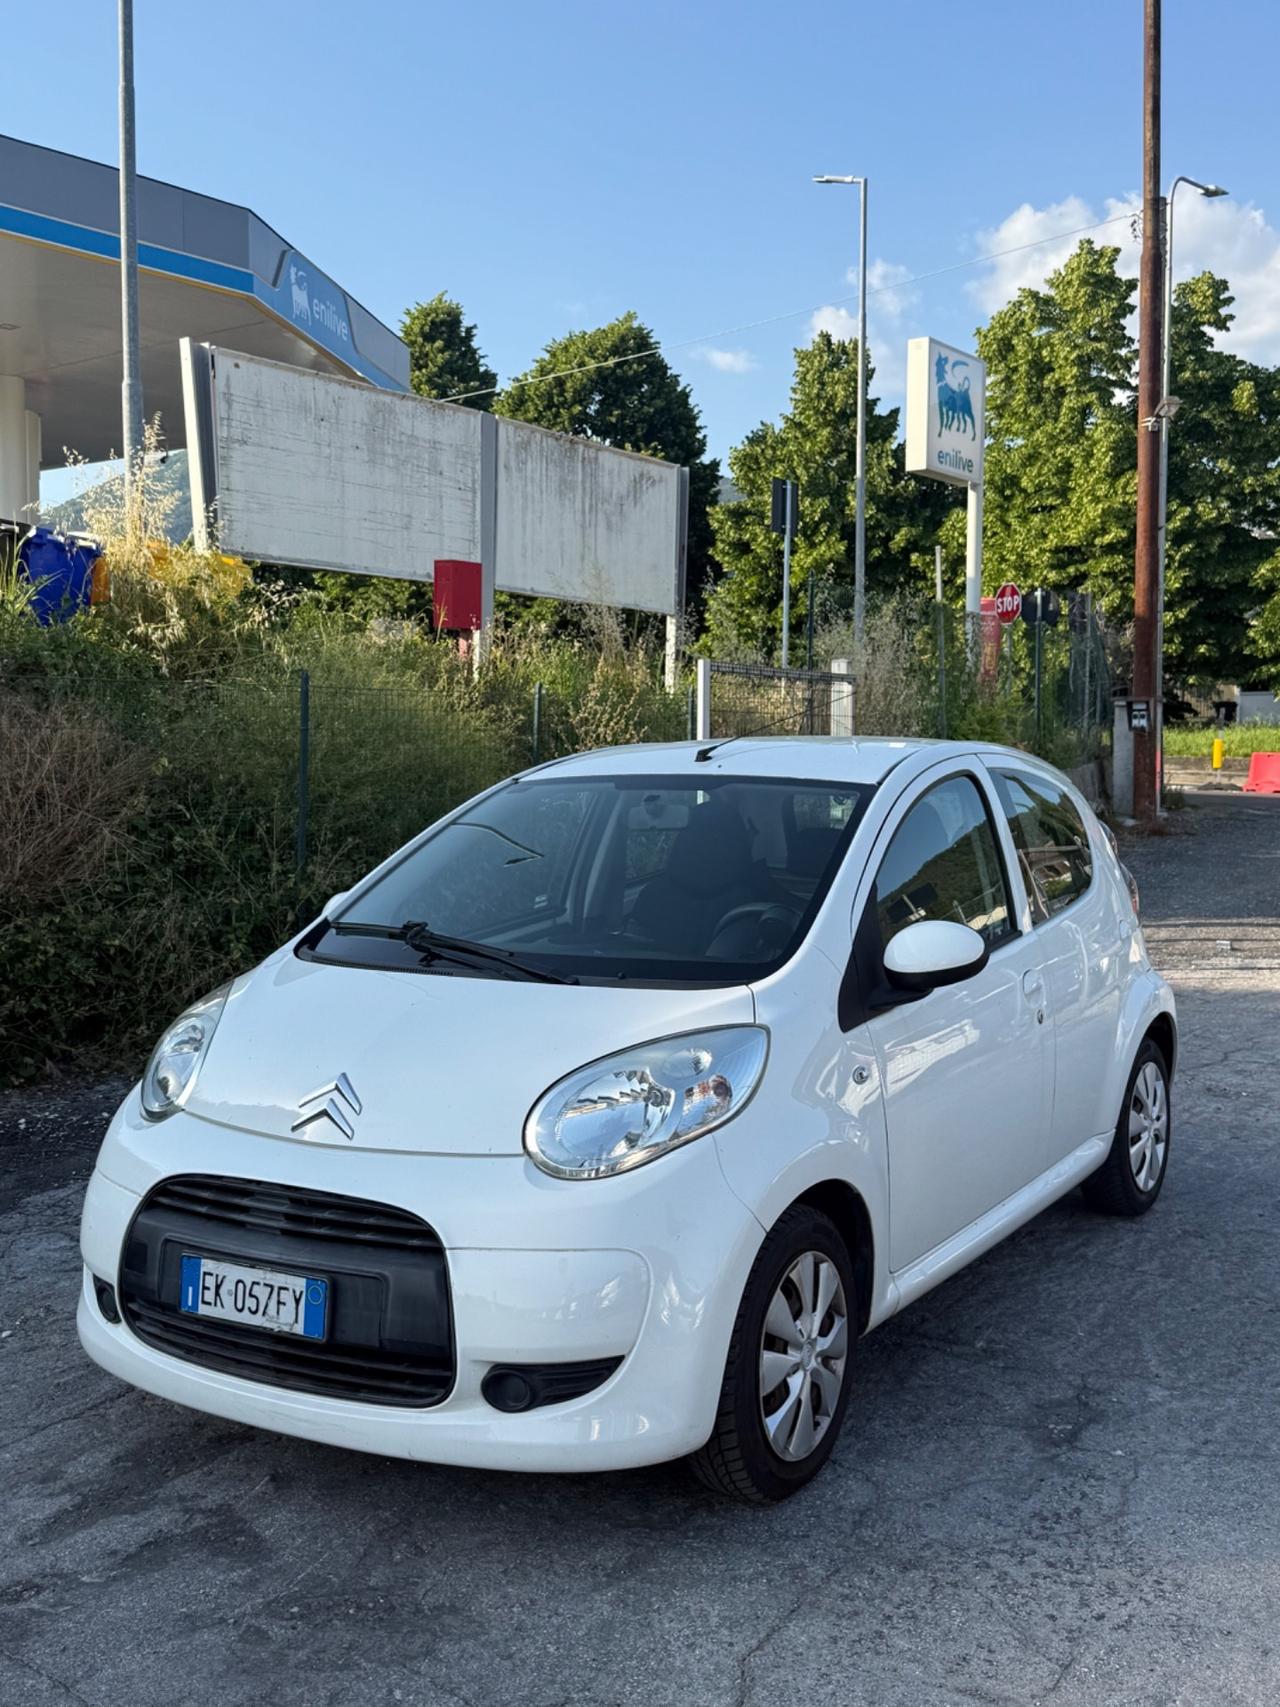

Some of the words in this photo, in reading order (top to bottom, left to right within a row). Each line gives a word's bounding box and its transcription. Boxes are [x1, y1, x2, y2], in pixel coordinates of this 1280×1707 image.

[312, 298, 348, 341] enilive
[937, 448, 974, 473] enilive
[997, 595, 1020, 613] STOP
[201, 1271, 227, 1309] EK
[233, 1278, 304, 1324] 057FY
